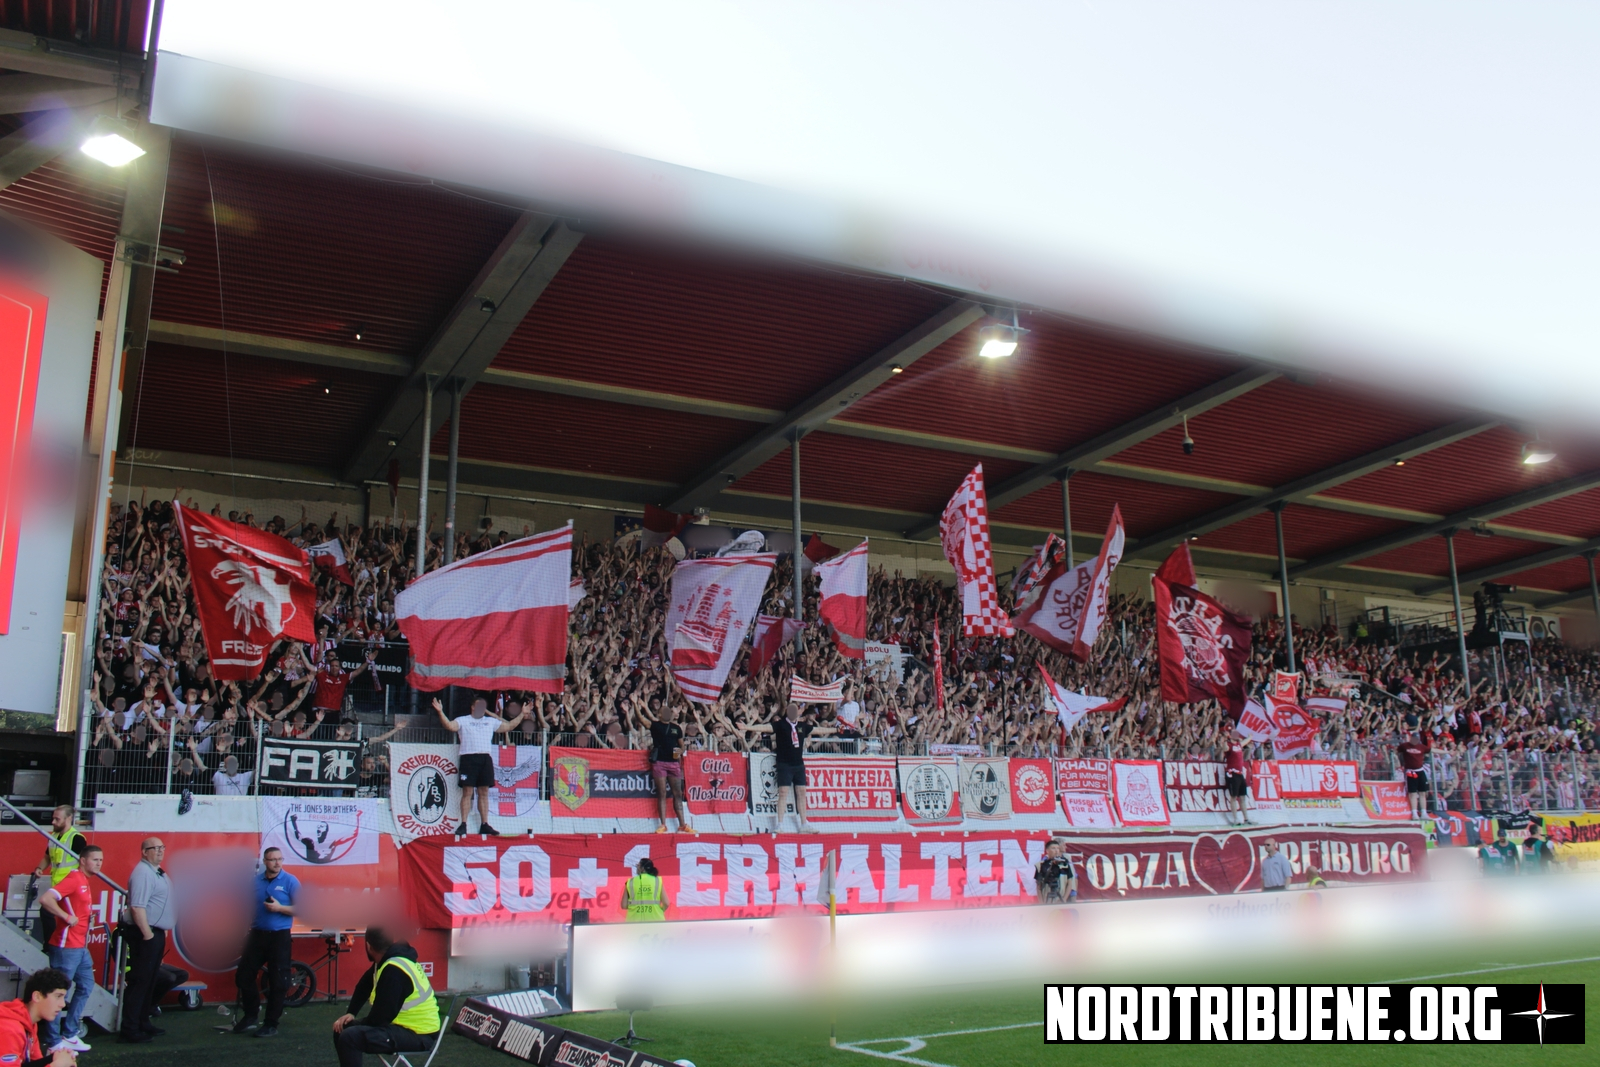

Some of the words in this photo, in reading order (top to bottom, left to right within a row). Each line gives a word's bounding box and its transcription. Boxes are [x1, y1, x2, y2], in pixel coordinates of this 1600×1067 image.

[261, 746, 320, 780] FA
[397, 754, 458, 776] FREIBURGER
[1060, 761, 1107, 772] KHALID
[1164, 762, 1228, 786] FIGHT
[805, 769, 893, 787] SYNTHESIA
[1060, 771, 1078, 780] FÜR
[1079, 773, 1107, 781] IMMER
[290, 803, 302, 813] THE
[303, 804, 323, 814] JONES
[806, 790, 869, 809] ULTRAS
[873, 791, 893, 808] 79
[1123, 801, 1160, 816] ULTRAS
[397, 814, 458, 836] BOTSCHAFT
[443, 844, 551, 916] 50
[676, 839, 1045, 908] ERHALTEN
[1064, 851, 1190, 891] FORZA
[636, 905, 653, 913] 2378
[487, 989, 548, 1017] PUMA
[497, 1019, 541, 1059] PUMA
